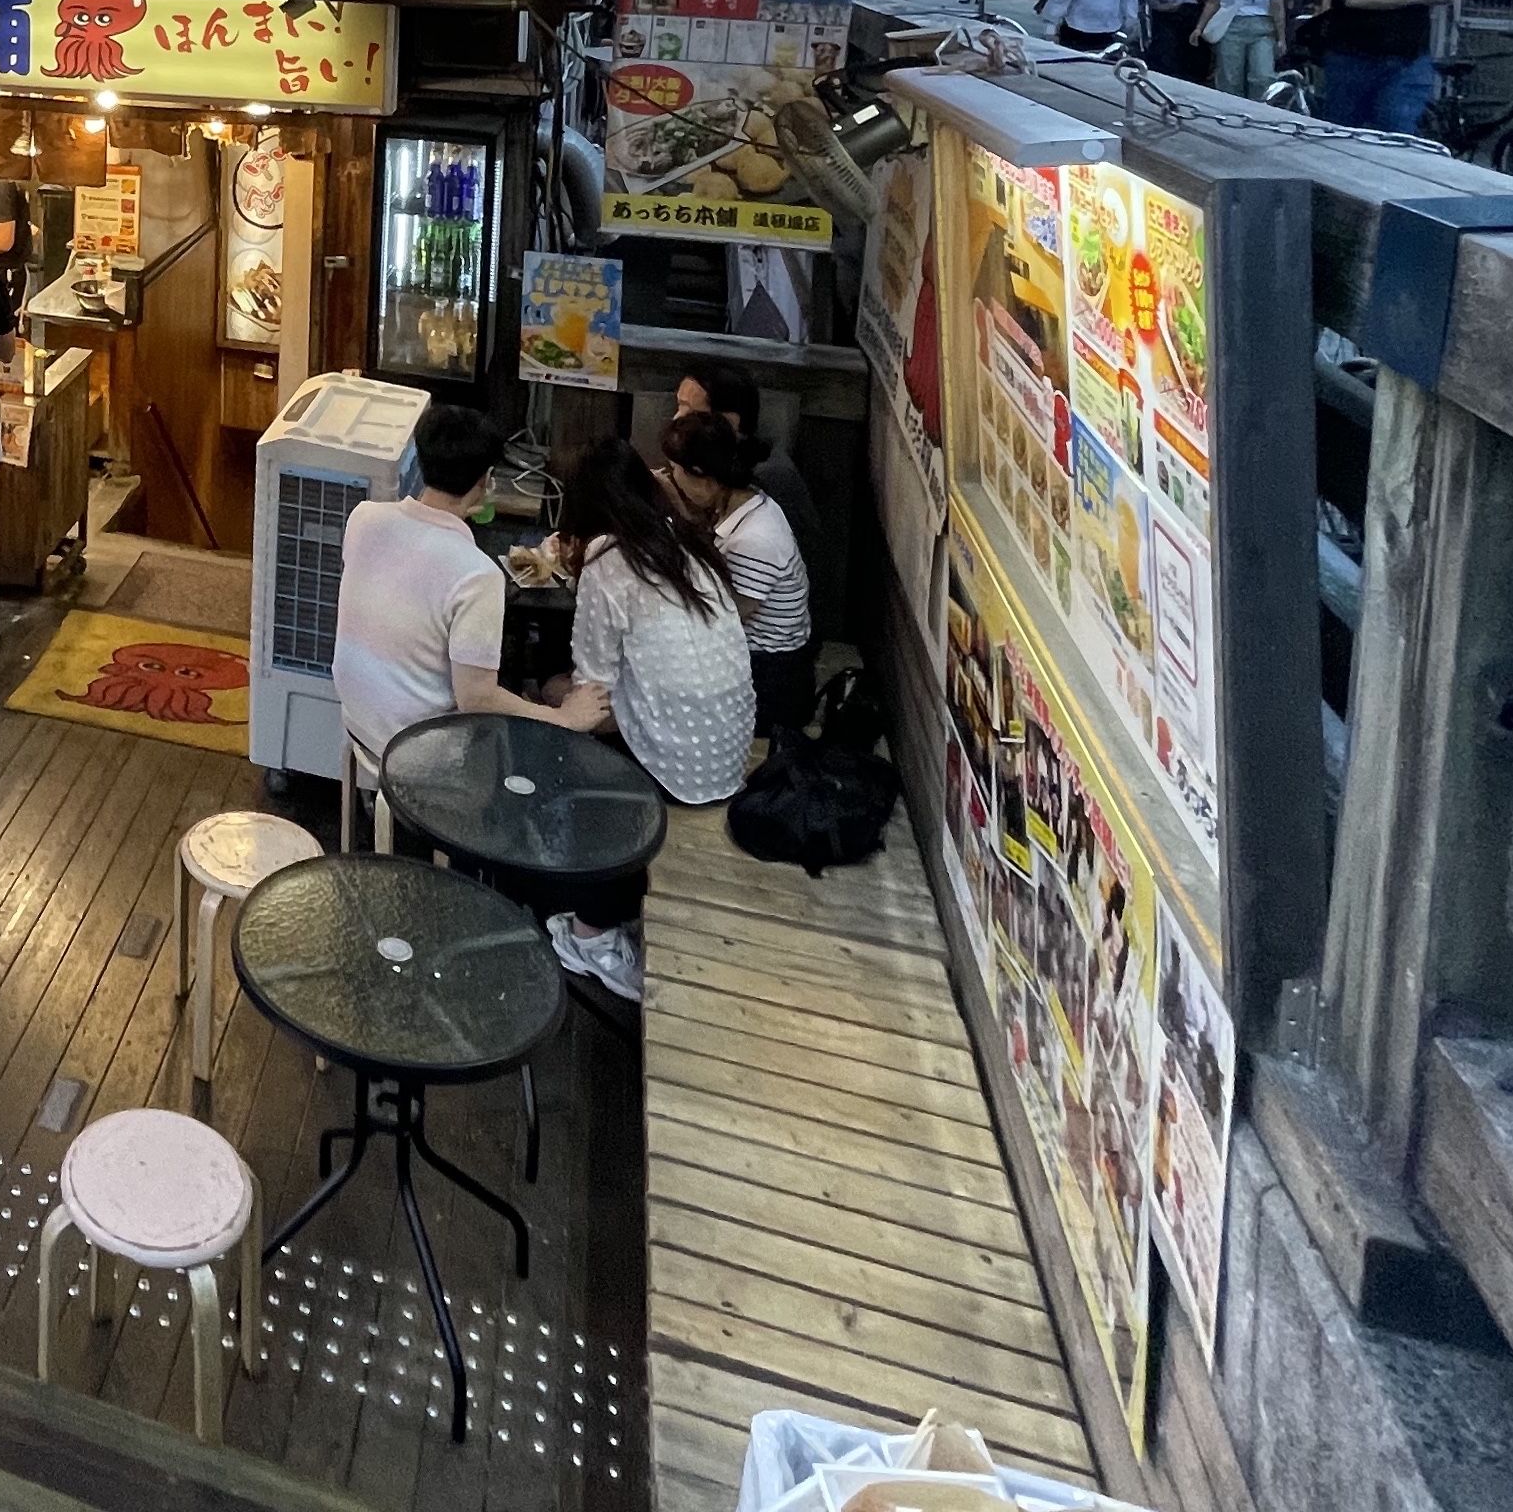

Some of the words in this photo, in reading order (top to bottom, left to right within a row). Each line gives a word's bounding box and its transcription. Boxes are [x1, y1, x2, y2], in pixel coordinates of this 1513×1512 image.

[275, 42, 381, 95] 旨い!
[612, 201, 738, 228] あっちち本舗
